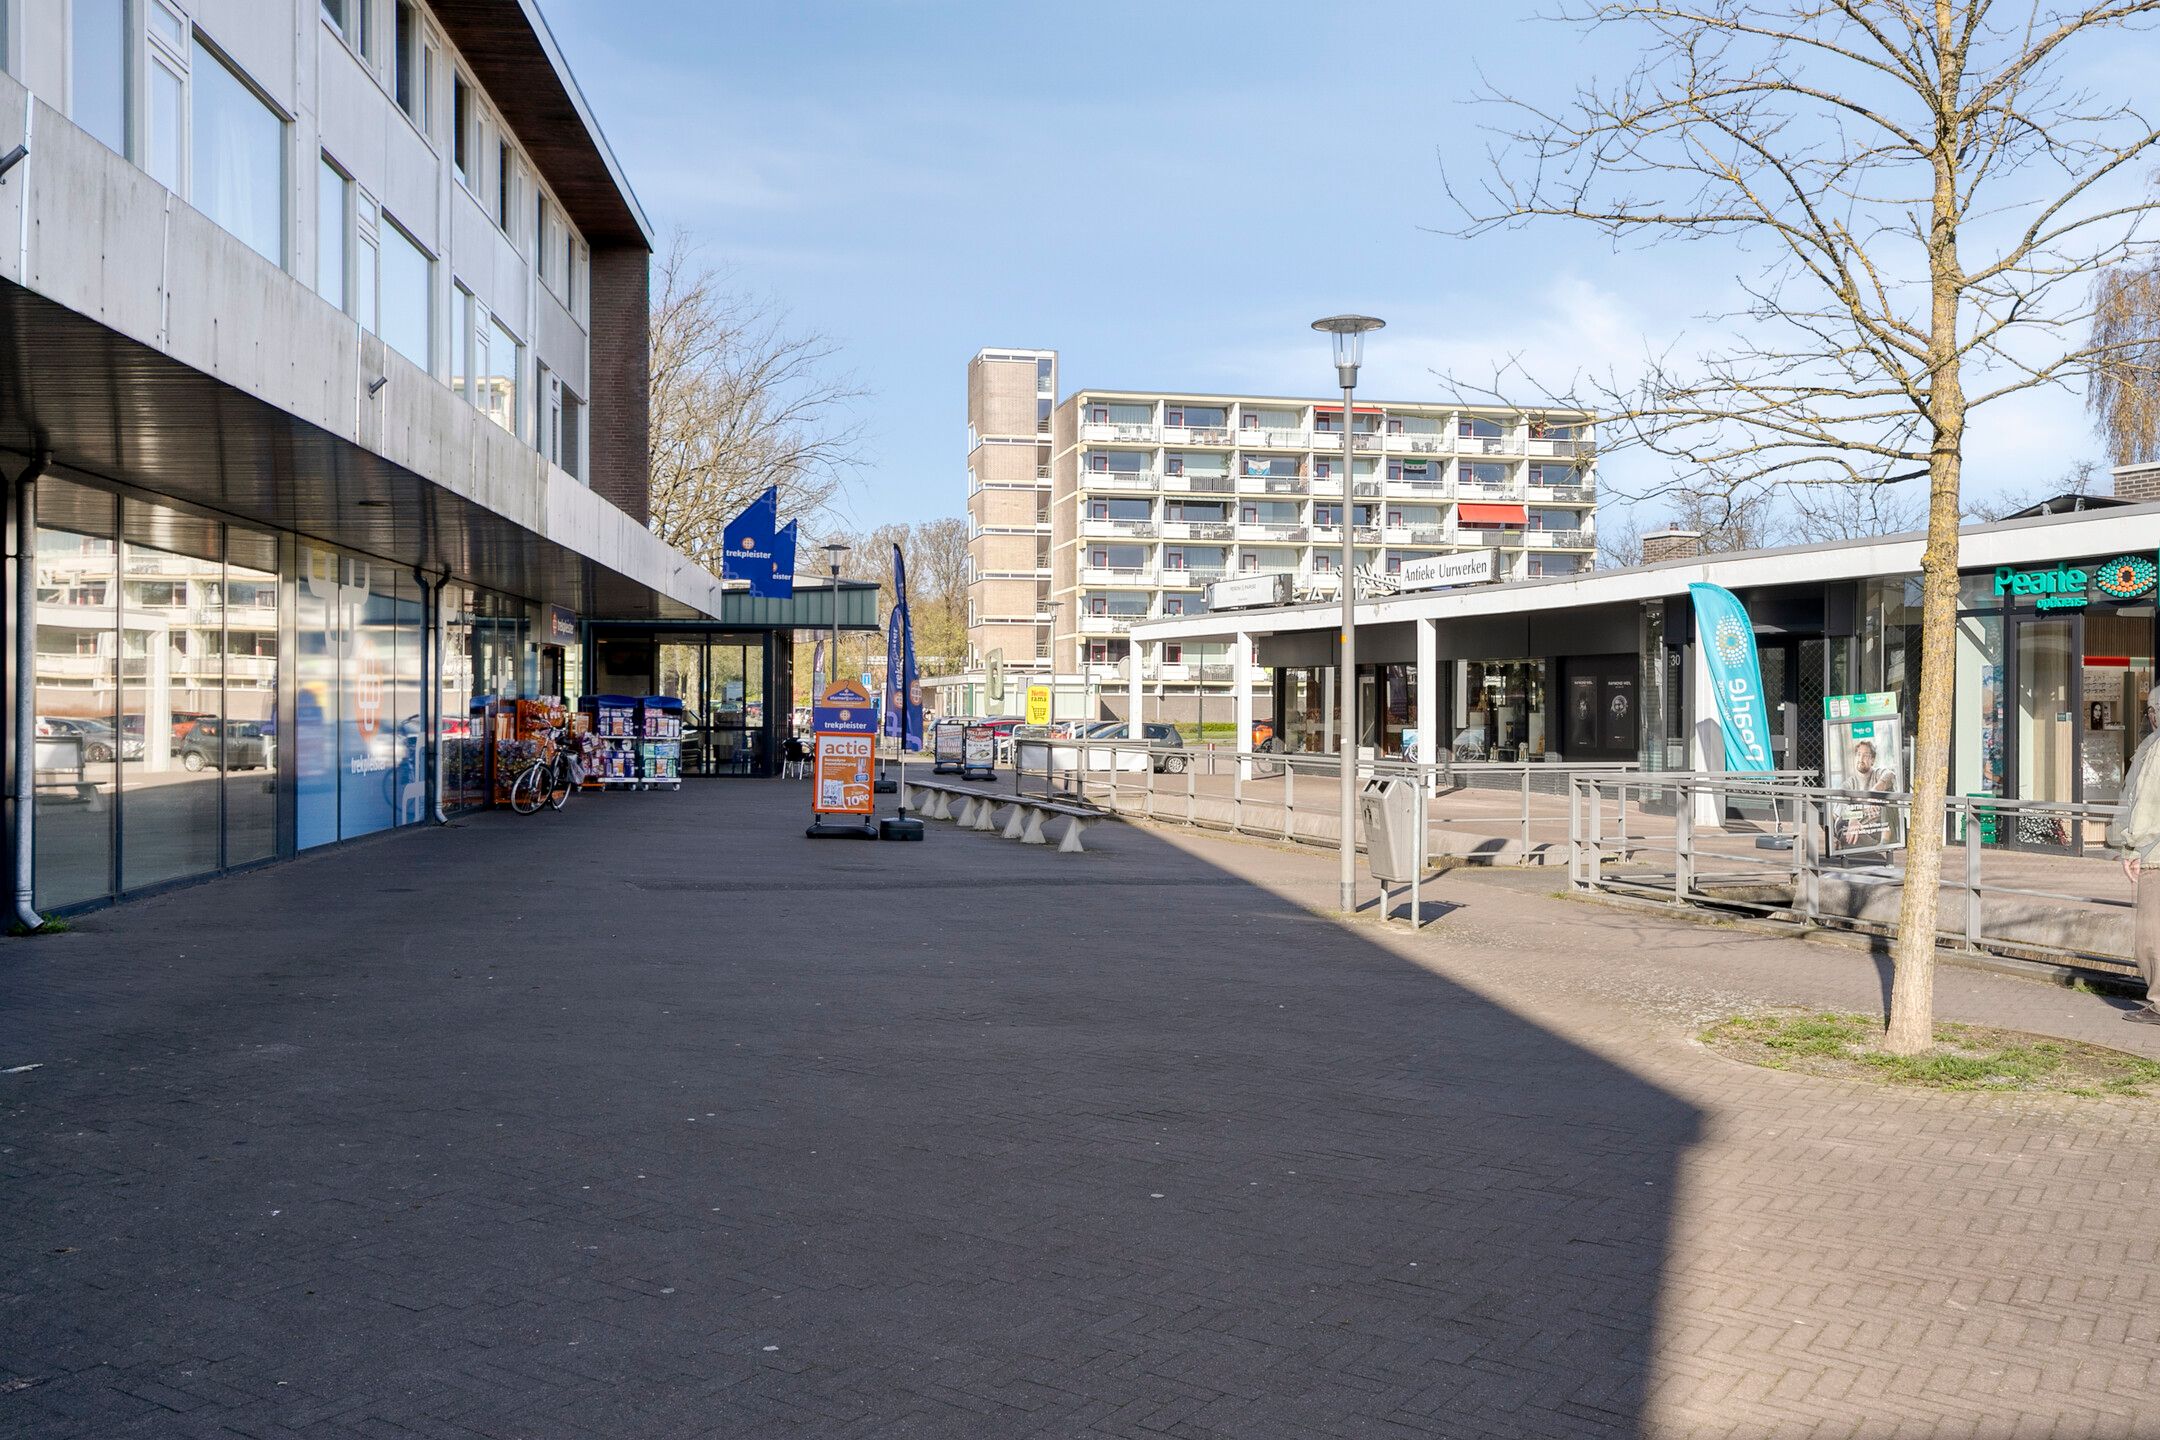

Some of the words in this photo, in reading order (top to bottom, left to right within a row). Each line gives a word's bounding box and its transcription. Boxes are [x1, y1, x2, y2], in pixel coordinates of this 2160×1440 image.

[725, 549, 772, 559] trekpleister
[1403, 564, 1436, 582] Antieke
[1439, 557, 1488, 579] Uurwerken
[1994, 564, 2088, 597] Pearle
[1670, 654, 1681, 666] 30
[824, 721, 867, 730] trekpleister
[825, 740, 868, 755] actie
